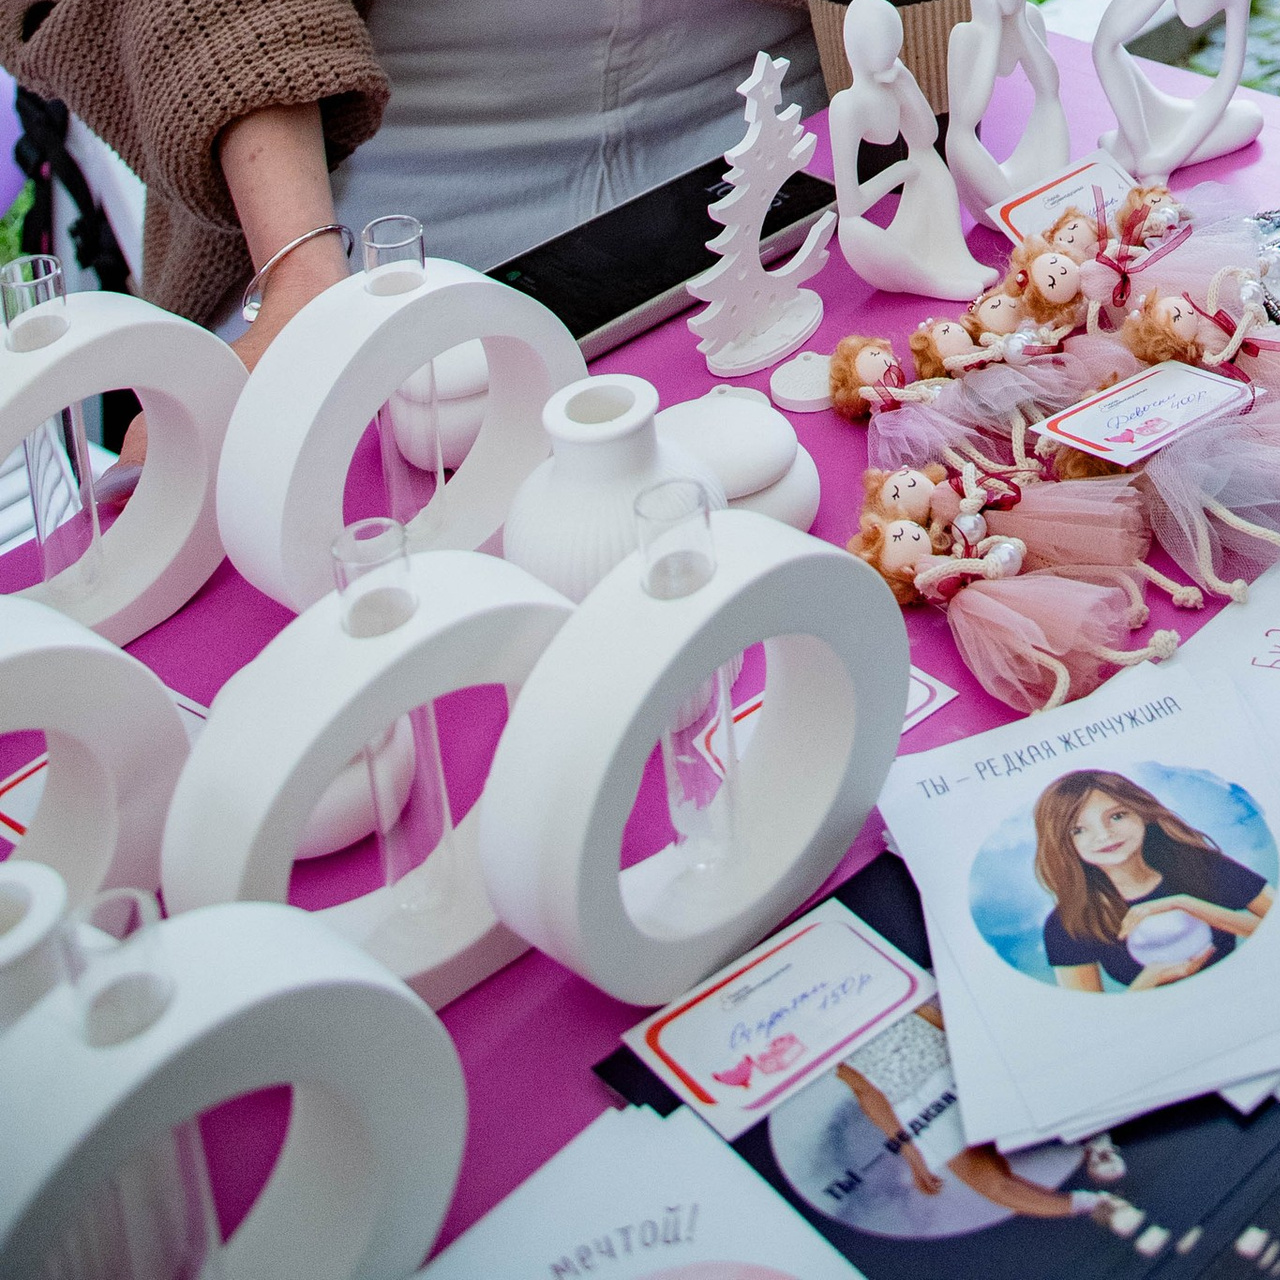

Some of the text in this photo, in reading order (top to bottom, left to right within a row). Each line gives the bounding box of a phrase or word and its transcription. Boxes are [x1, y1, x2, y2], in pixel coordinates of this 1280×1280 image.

[917, 775, 950, 798] ТЫ
[974, 740, 1057, 780] РЕДКАЯ
[1057, 695, 1182, 753] ЖЕМЧУЖИНА
